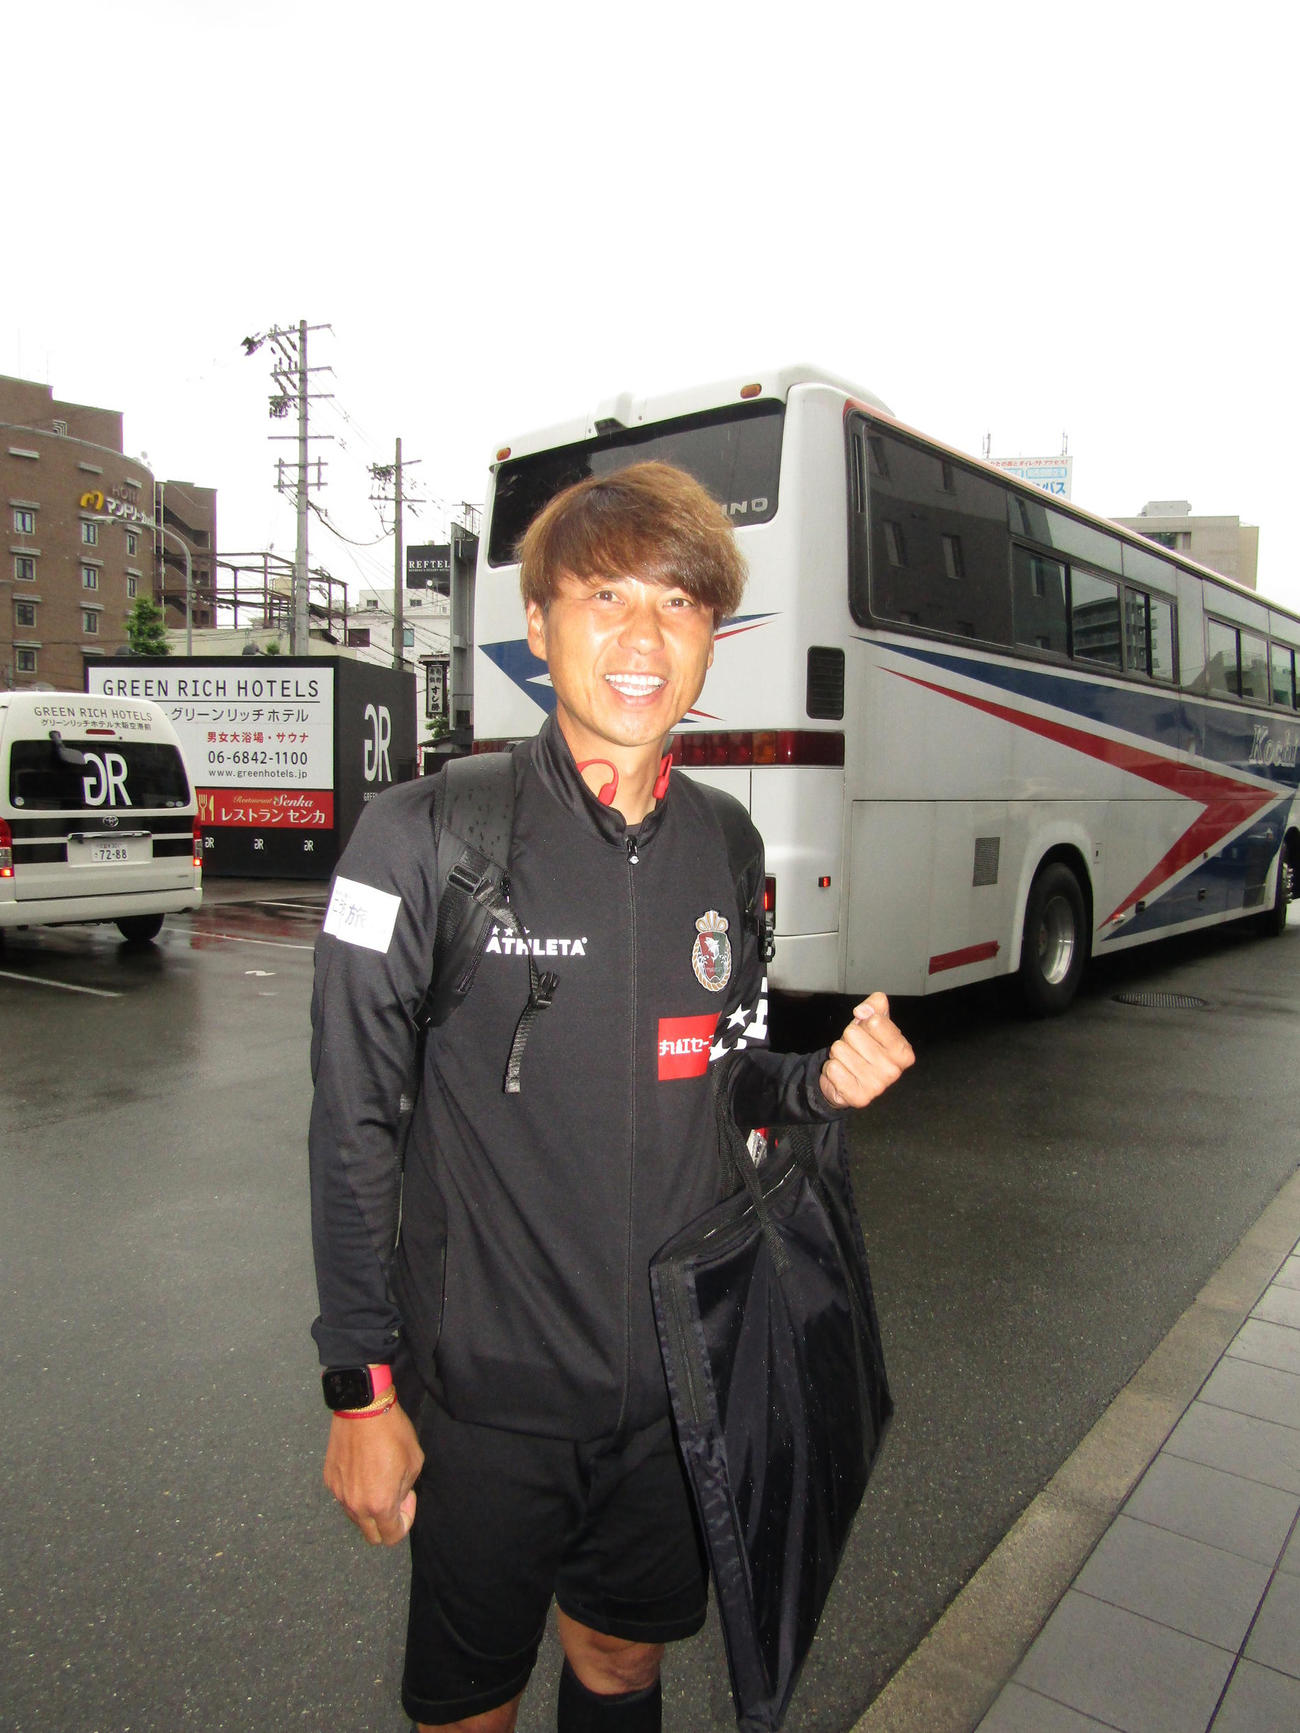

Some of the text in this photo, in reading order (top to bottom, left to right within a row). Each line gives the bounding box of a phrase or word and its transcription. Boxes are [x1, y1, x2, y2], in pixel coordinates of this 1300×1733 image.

[721, 498, 769, 516] INO
[408, 560, 450, 569] REFTEL
[103, 679, 319, 698] GREEN RICH HOTELS
[34, 706, 152, 722] GREEN RICH HOTELS
[171, 707, 309, 723] グリーンリッチホテル
[207, 731, 310, 744] 男女大浴場・サウナ
[208, 750, 309, 765] 06-6842-1100
[208, 768, 309, 779] www.greenhotels.jp
[273, 794, 314, 808] Senka
[99, 849, 128, 860] 72-88
